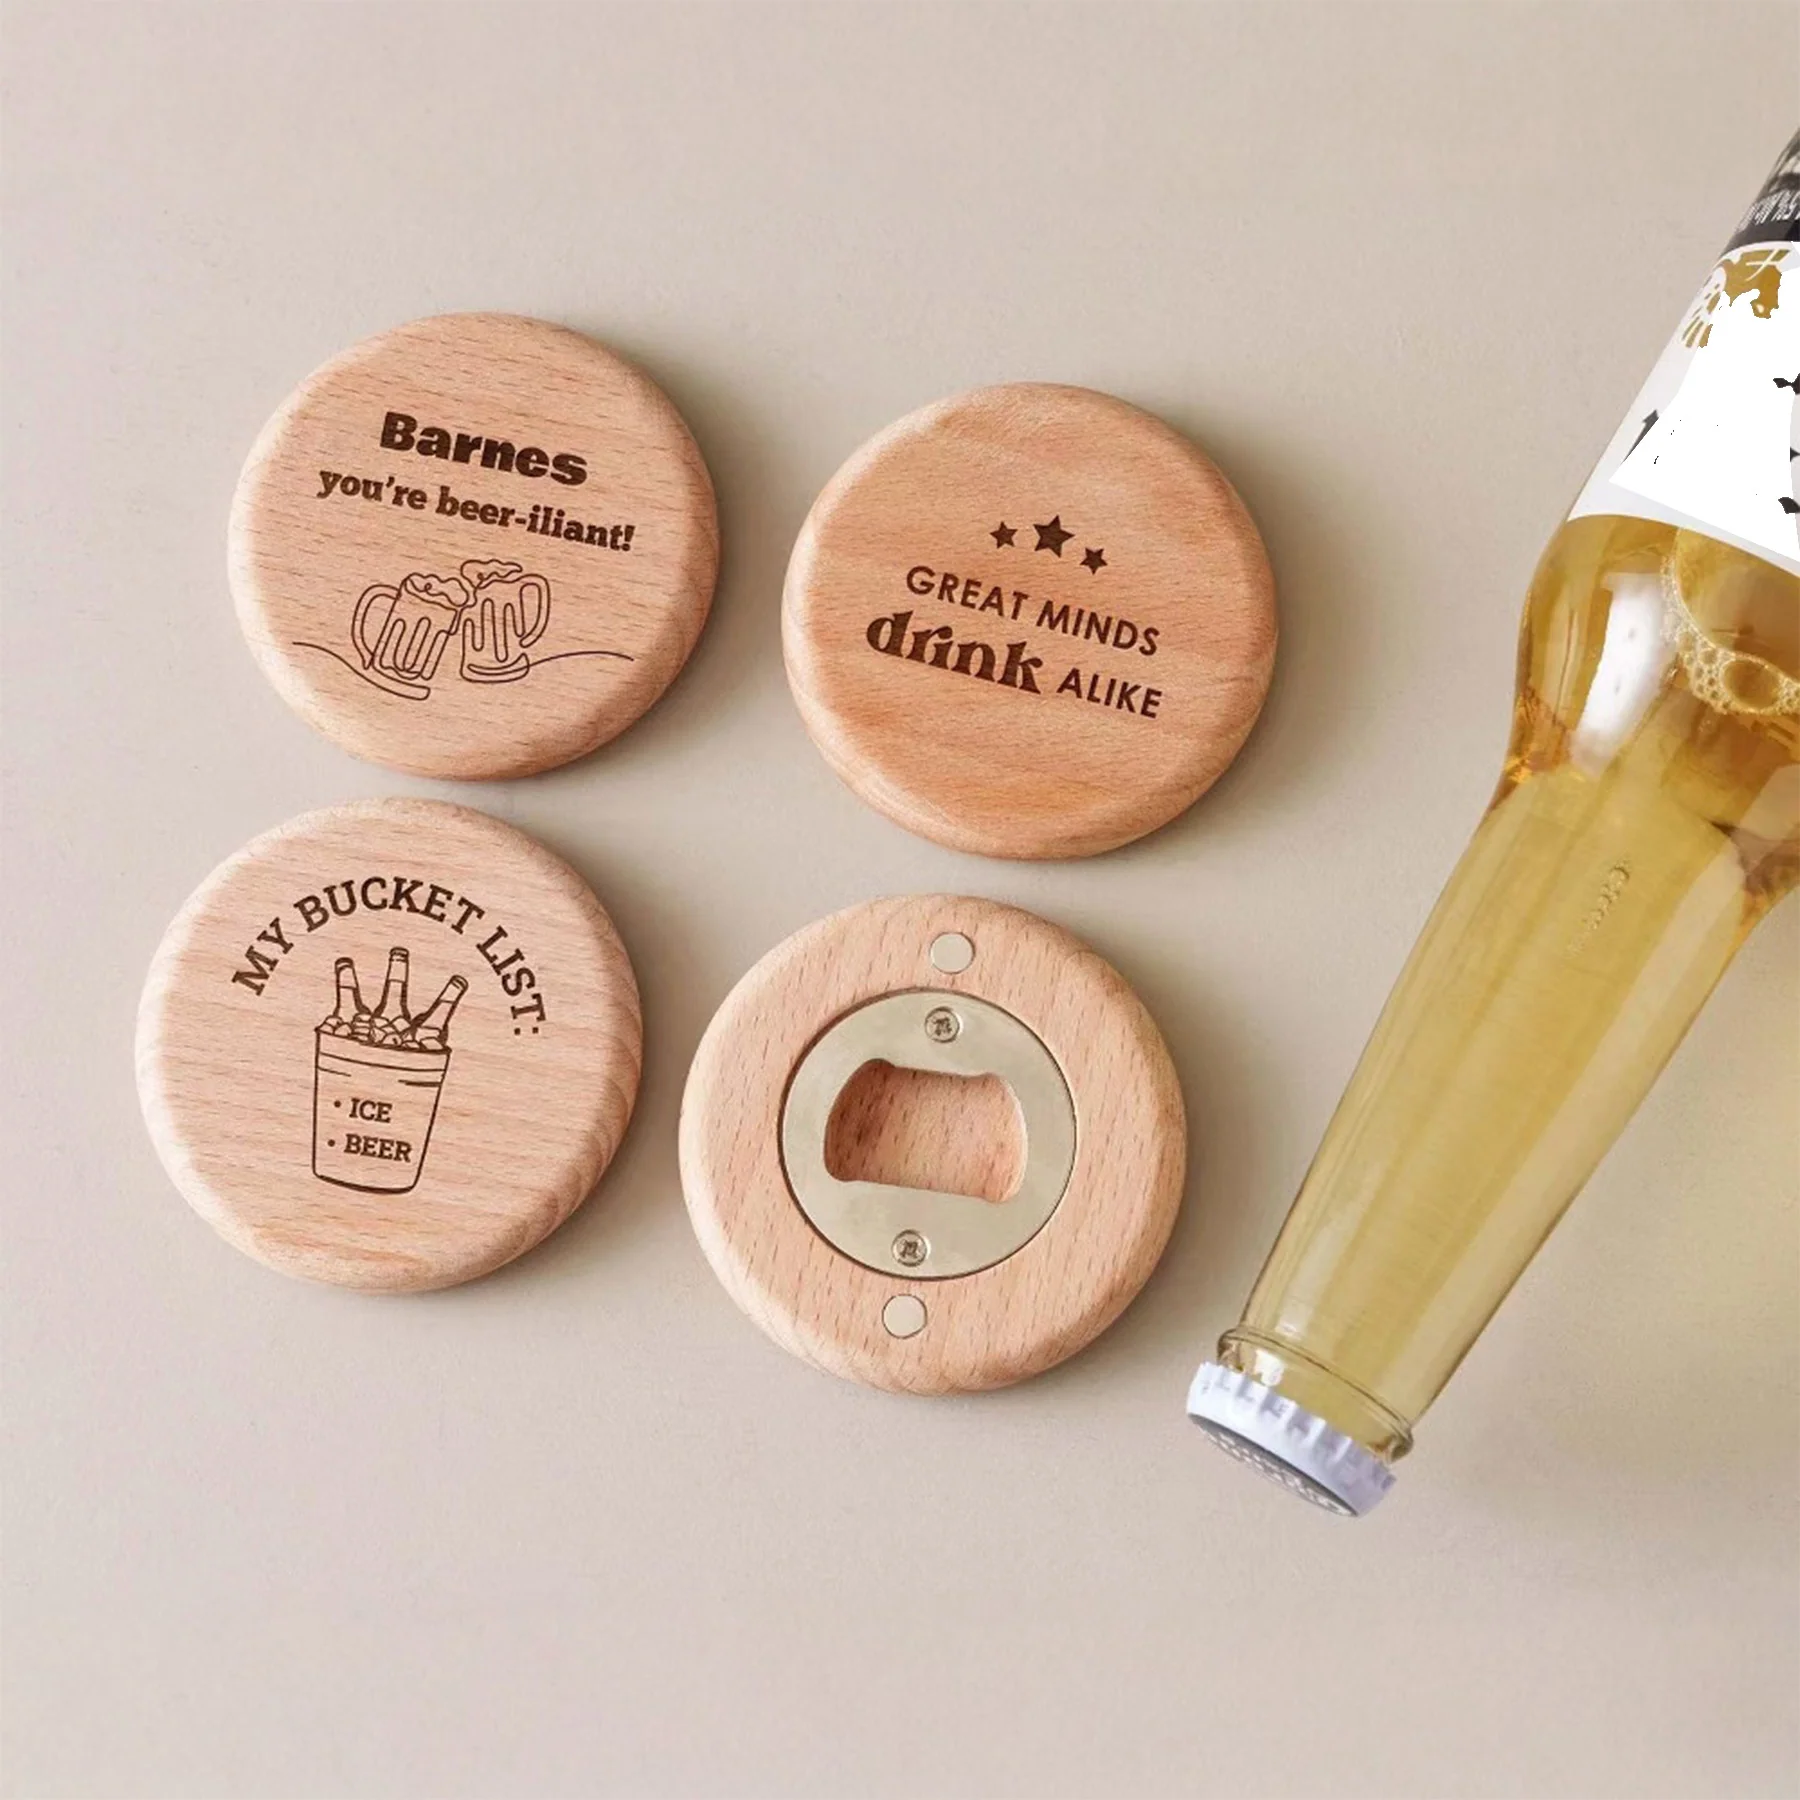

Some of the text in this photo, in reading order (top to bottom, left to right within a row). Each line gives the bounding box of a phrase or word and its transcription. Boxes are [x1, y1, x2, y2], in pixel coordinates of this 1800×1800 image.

[379, 411, 588, 485] Barnes
[316, 470, 636, 552] you're beer-iliant!
[905, 565, 1161, 657] GREAT MINDS
[865, 609, 1163, 719] drink ALIKE
[231, 876, 546, 1036] MY BUCKET LIST:
[343, 1133, 413, 1163] BEER
[348, 1097, 393, 1124] ICE
